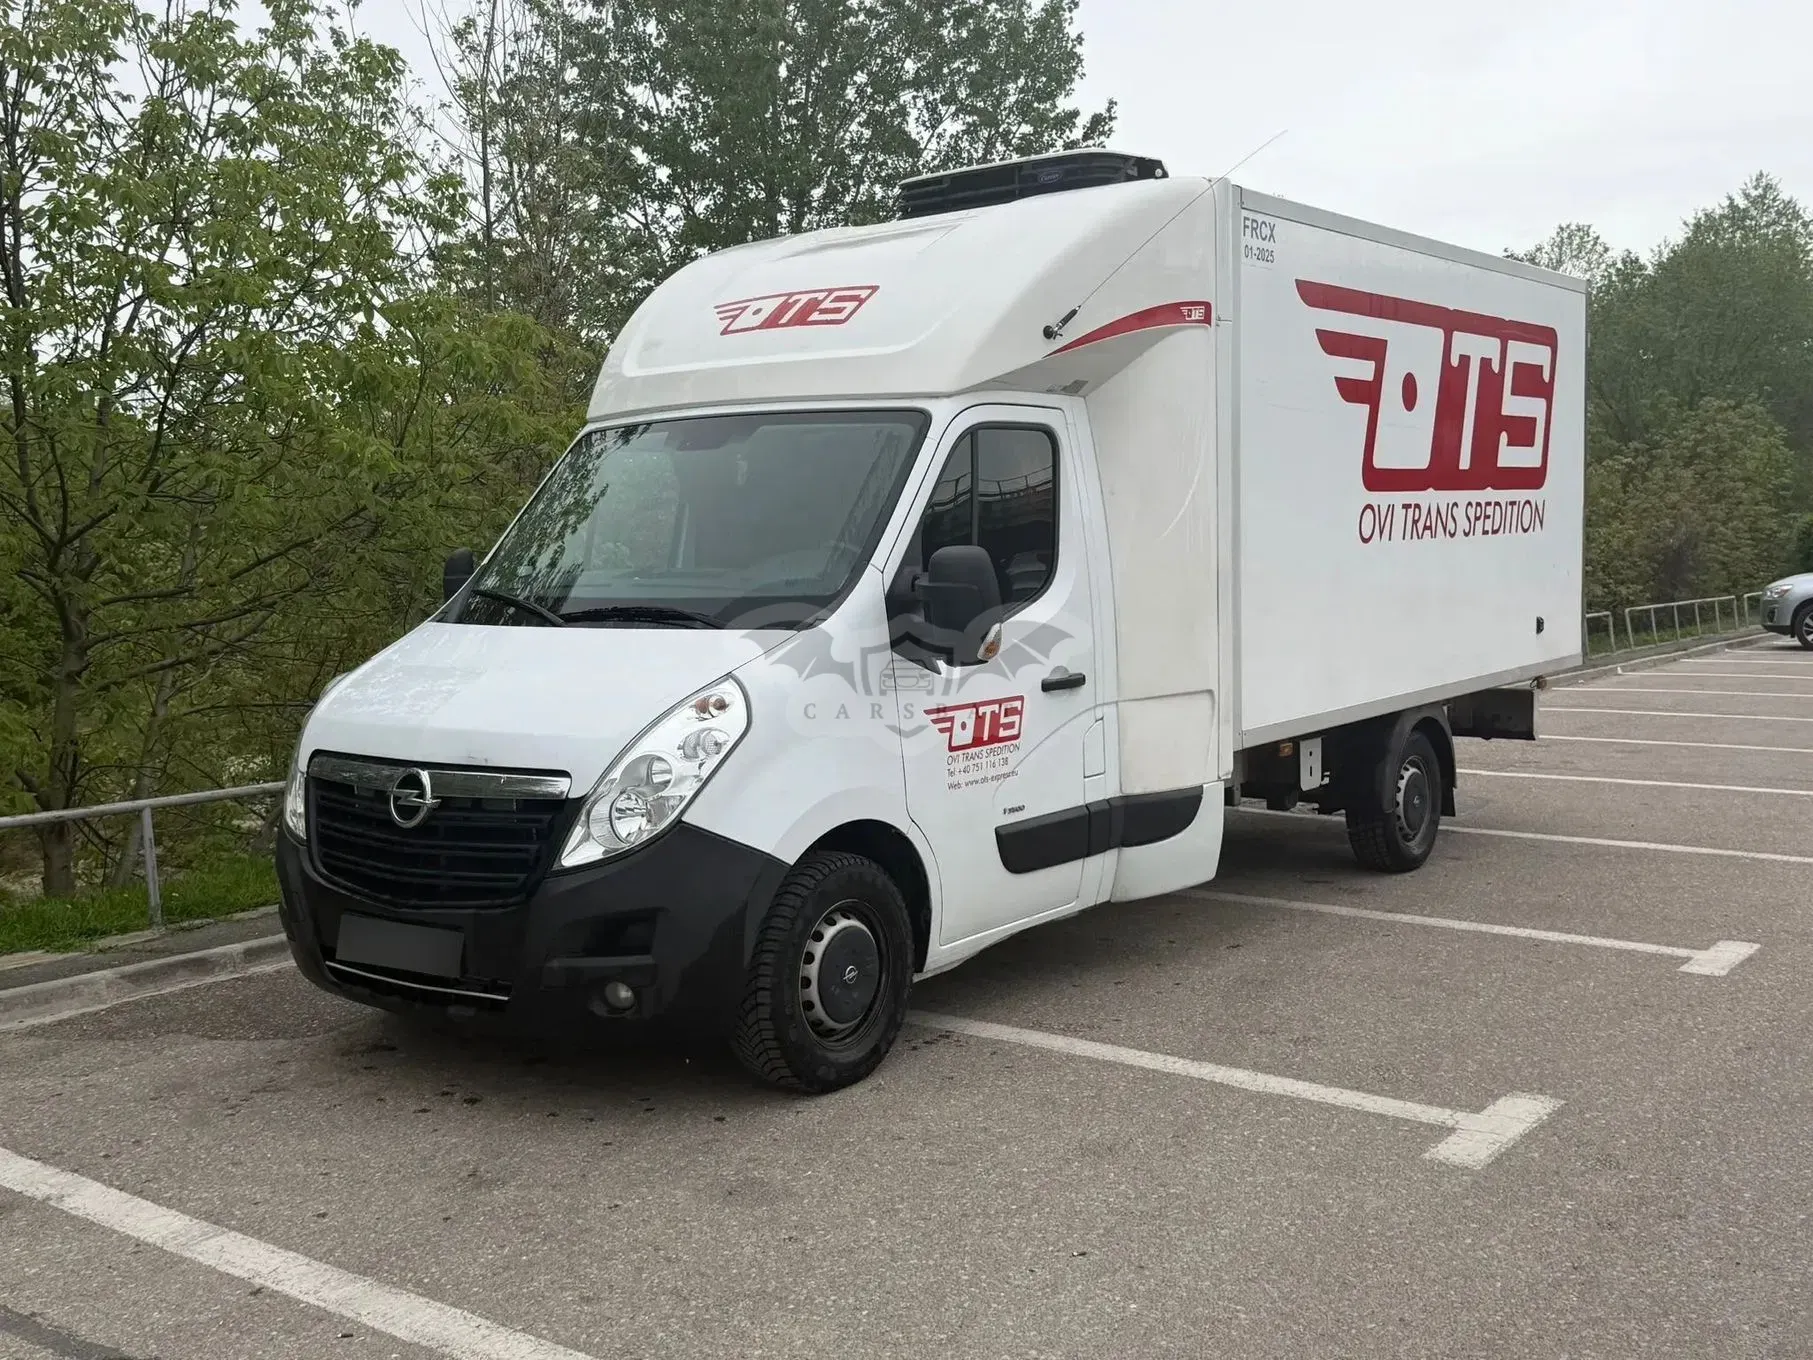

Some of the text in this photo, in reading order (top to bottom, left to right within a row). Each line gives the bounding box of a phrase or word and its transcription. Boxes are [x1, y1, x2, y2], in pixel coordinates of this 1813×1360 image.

[1243, 215, 1276, 244] FRCX
[1244, 244, 1275, 264] 01-2025
[722, 286, 878, 335] OTS
[1184, 306, 1205, 320] OTS
[1362, 318, 1557, 490] OTS
[1358, 499, 1546, 544] OVI TRANS SPEDITION
[945, 697, 1024, 752] OTS
[947, 743, 1020, 766] OVI TRANS SPEDITION
[958, 764, 970, 775] +40
[972, 762, 983, 772] 751
[986, 759, 997, 769] 116
[998, 756, 1009, 767] 138
